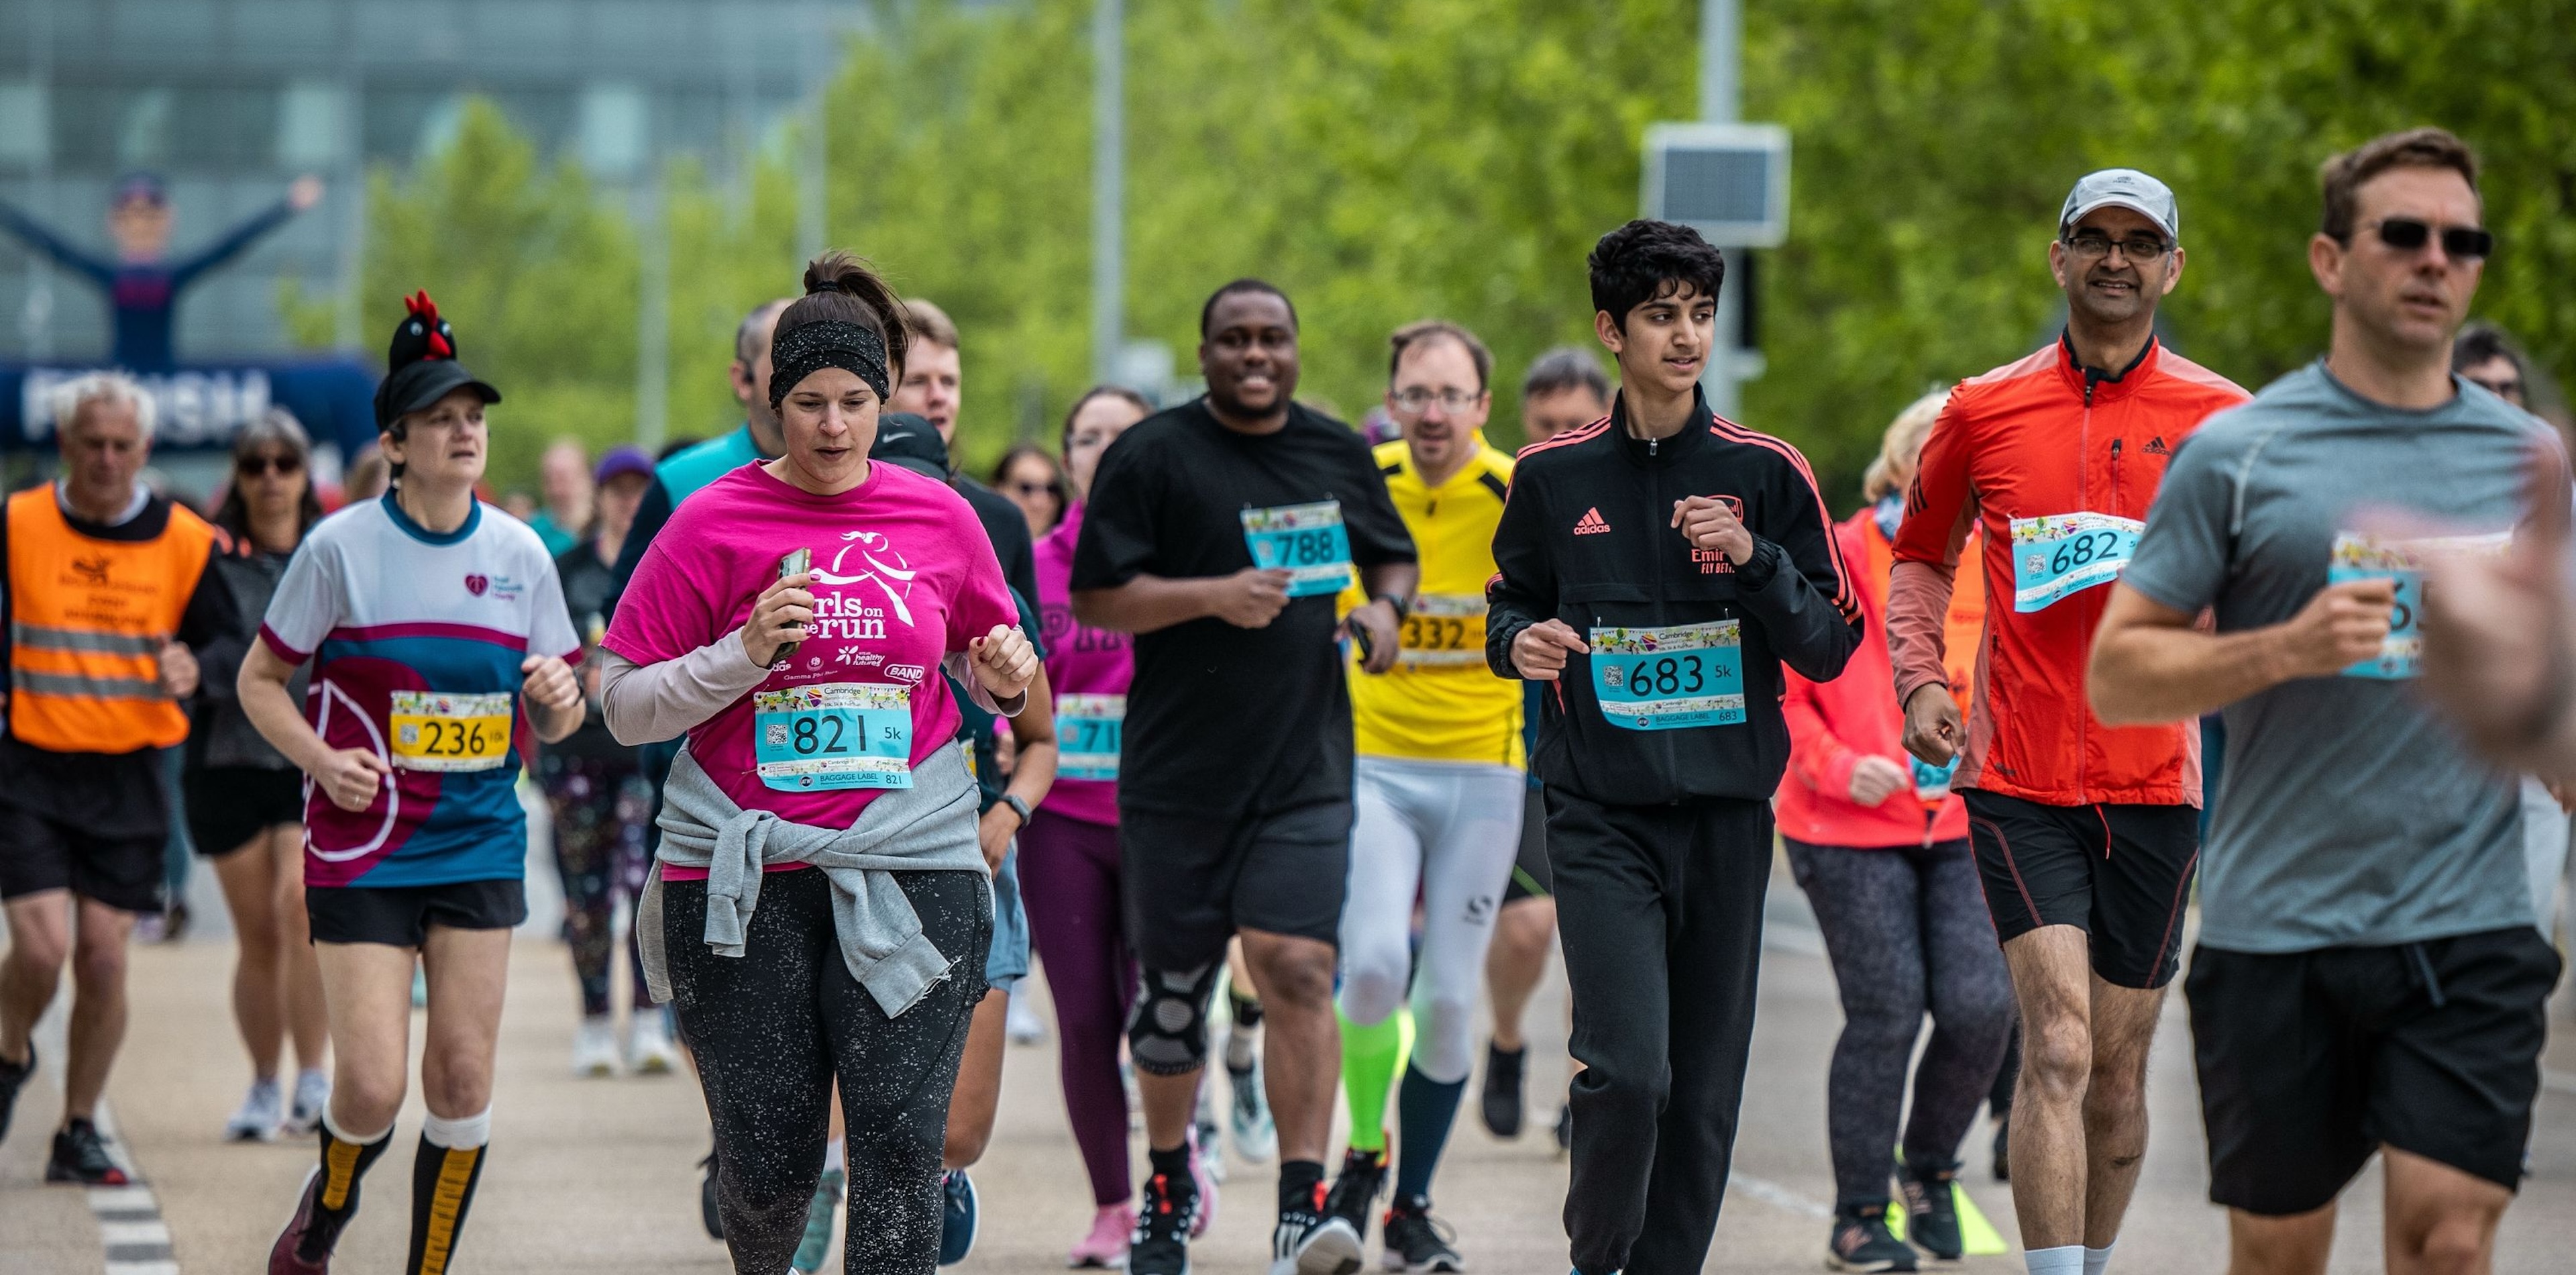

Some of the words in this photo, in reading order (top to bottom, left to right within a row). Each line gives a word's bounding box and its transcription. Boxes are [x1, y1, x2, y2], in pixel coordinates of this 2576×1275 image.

[1574, 523, 1611, 536] adidas
[1276, 530, 1335, 568] 788
[1691, 548, 1725, 562] Emir
[2052, 531, 2118, 574] 682
[1701, 563, 1714, 574] FLY
[1715, 562, 1735, 574] BET
[812, 591, 863, 617] rls
[863, 607, 884, 617] on
[818, 619, 887, 639] run
[1406, 617, 1466, 650] 332
[1658, 631, 1694, 640] Cambridge
[855, 654, 885, 663] healthy
[772, 663, 792, 672] das
[890, 666, 924, 680] BAND
[1715, 664, 1731, 678] 5k
[1629, 655, 1704, 697] 683
[824, 687, 861, 696] Cambridge
[1656, 714, 1690, 722] BAGGAGE
[1690, 712, 1711, 720] LABEL
[1719, 711, 1737, 722] 683
[425, 721, 486, 755] 236
[794, 715, 867, 754] 821
[884, 727, 902, 740] 5k
[1083, 723, 1116, 751] 71
[820, 774, 857, 782] BAGGAGE
[858, 772, 879, 780] LABEL
[886, 774, 902, 784] 821
